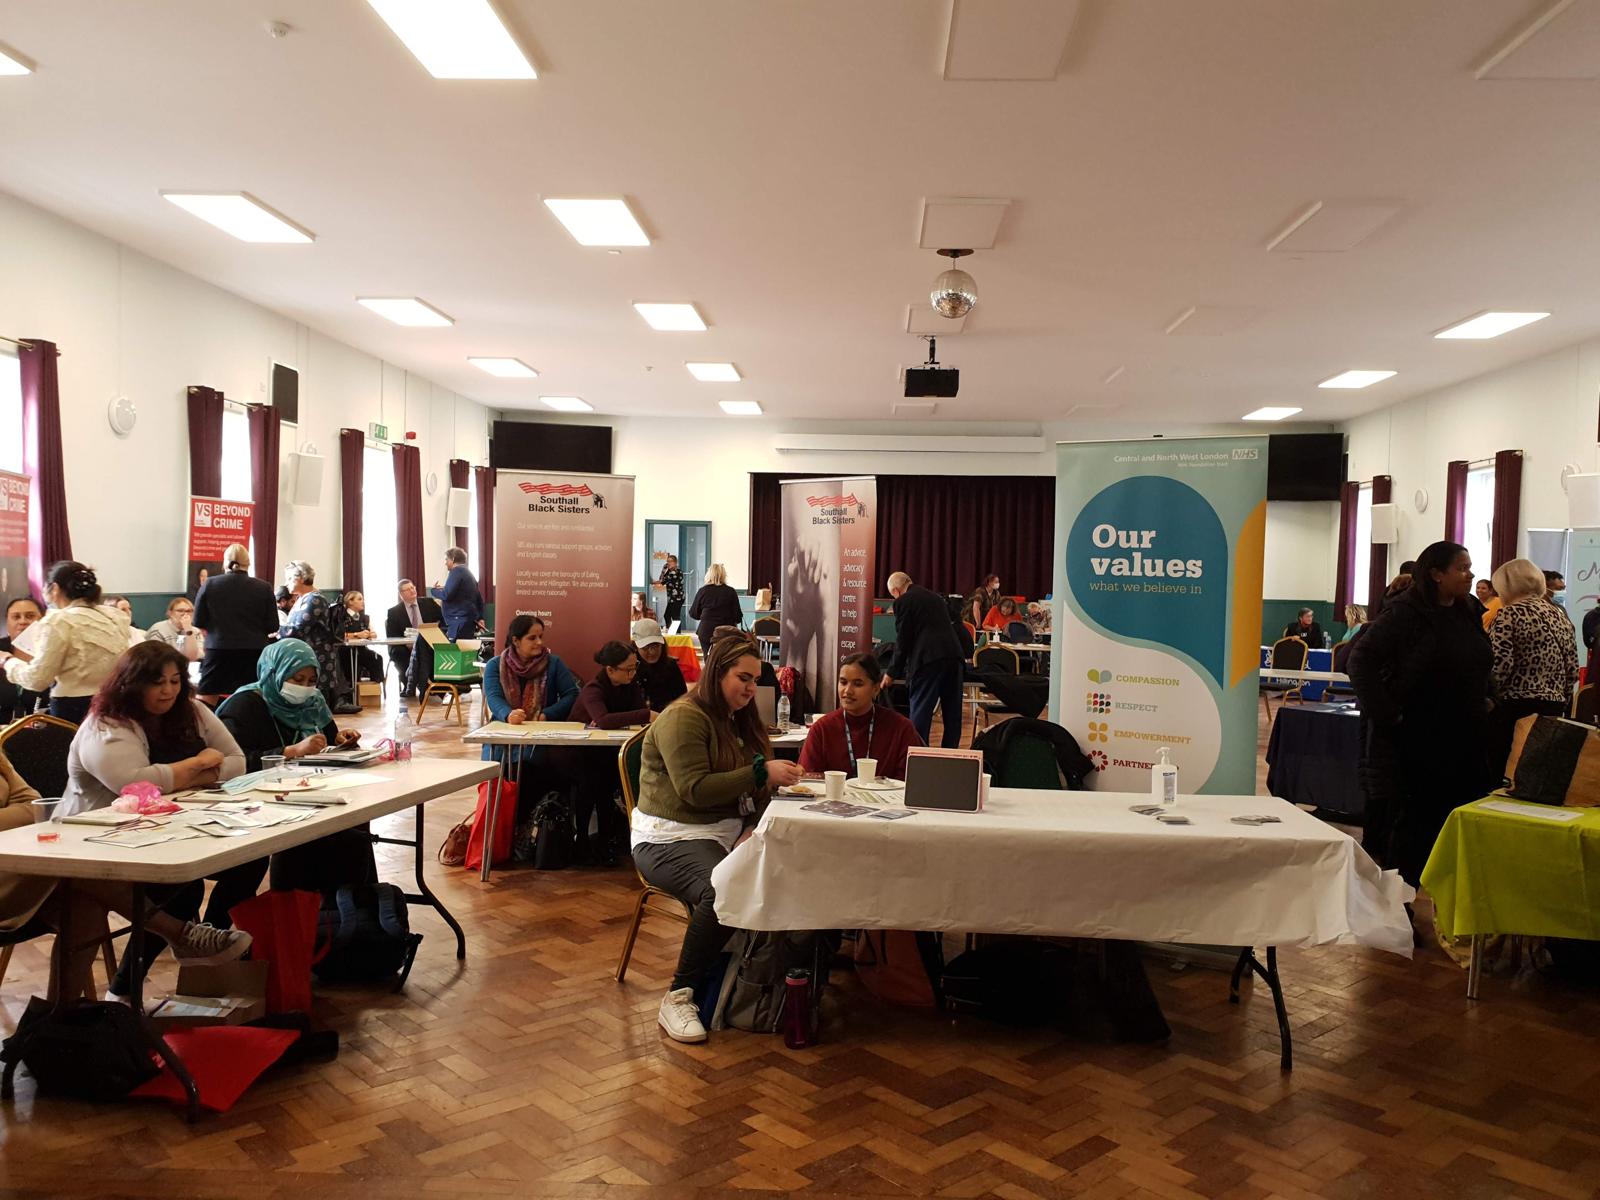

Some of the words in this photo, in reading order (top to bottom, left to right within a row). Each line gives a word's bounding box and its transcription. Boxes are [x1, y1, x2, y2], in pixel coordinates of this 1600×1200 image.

[1157, 453, 1178, 461] North
[1200, 452, 1228, 460] London
[1233, 449, 1257, 459] NHS
[540, 495, 579, 505] Southall
[196, 503, 211, 517] VS
[213, 504, 251, 518] BEYOND
[528, 504, 555, 513] Black
[558, 505, 590, 514] Sisters
[820, 508, 848, 516] Southall
[213, 517, 244, 530] CRIME
[812, 517, 831, 525] Black
[832, 516, 856, 525] Sisters
[1092, 524, 1156, 549] Our
[1090, 552, 1203, 578] values
[847, 579, 867, 588] resource
[1089, 581, 1119, 592] what
[1122, 584, 1140, 592] we
[1143, 582, 1186, 594] believe
[1190, 584, 1202, 595] in
[842, 595, 856, 603] centre
[538, 609, 552, 617] hours
[847, 610, 857, 620] help
[840, 641, 856, 651] escape
[1115, 674, 1180, 687] COMPASSION
[1115, 702, 1159, 713] RESPECT
[1113, 730, 1191, 745] EMPOWERMENT
